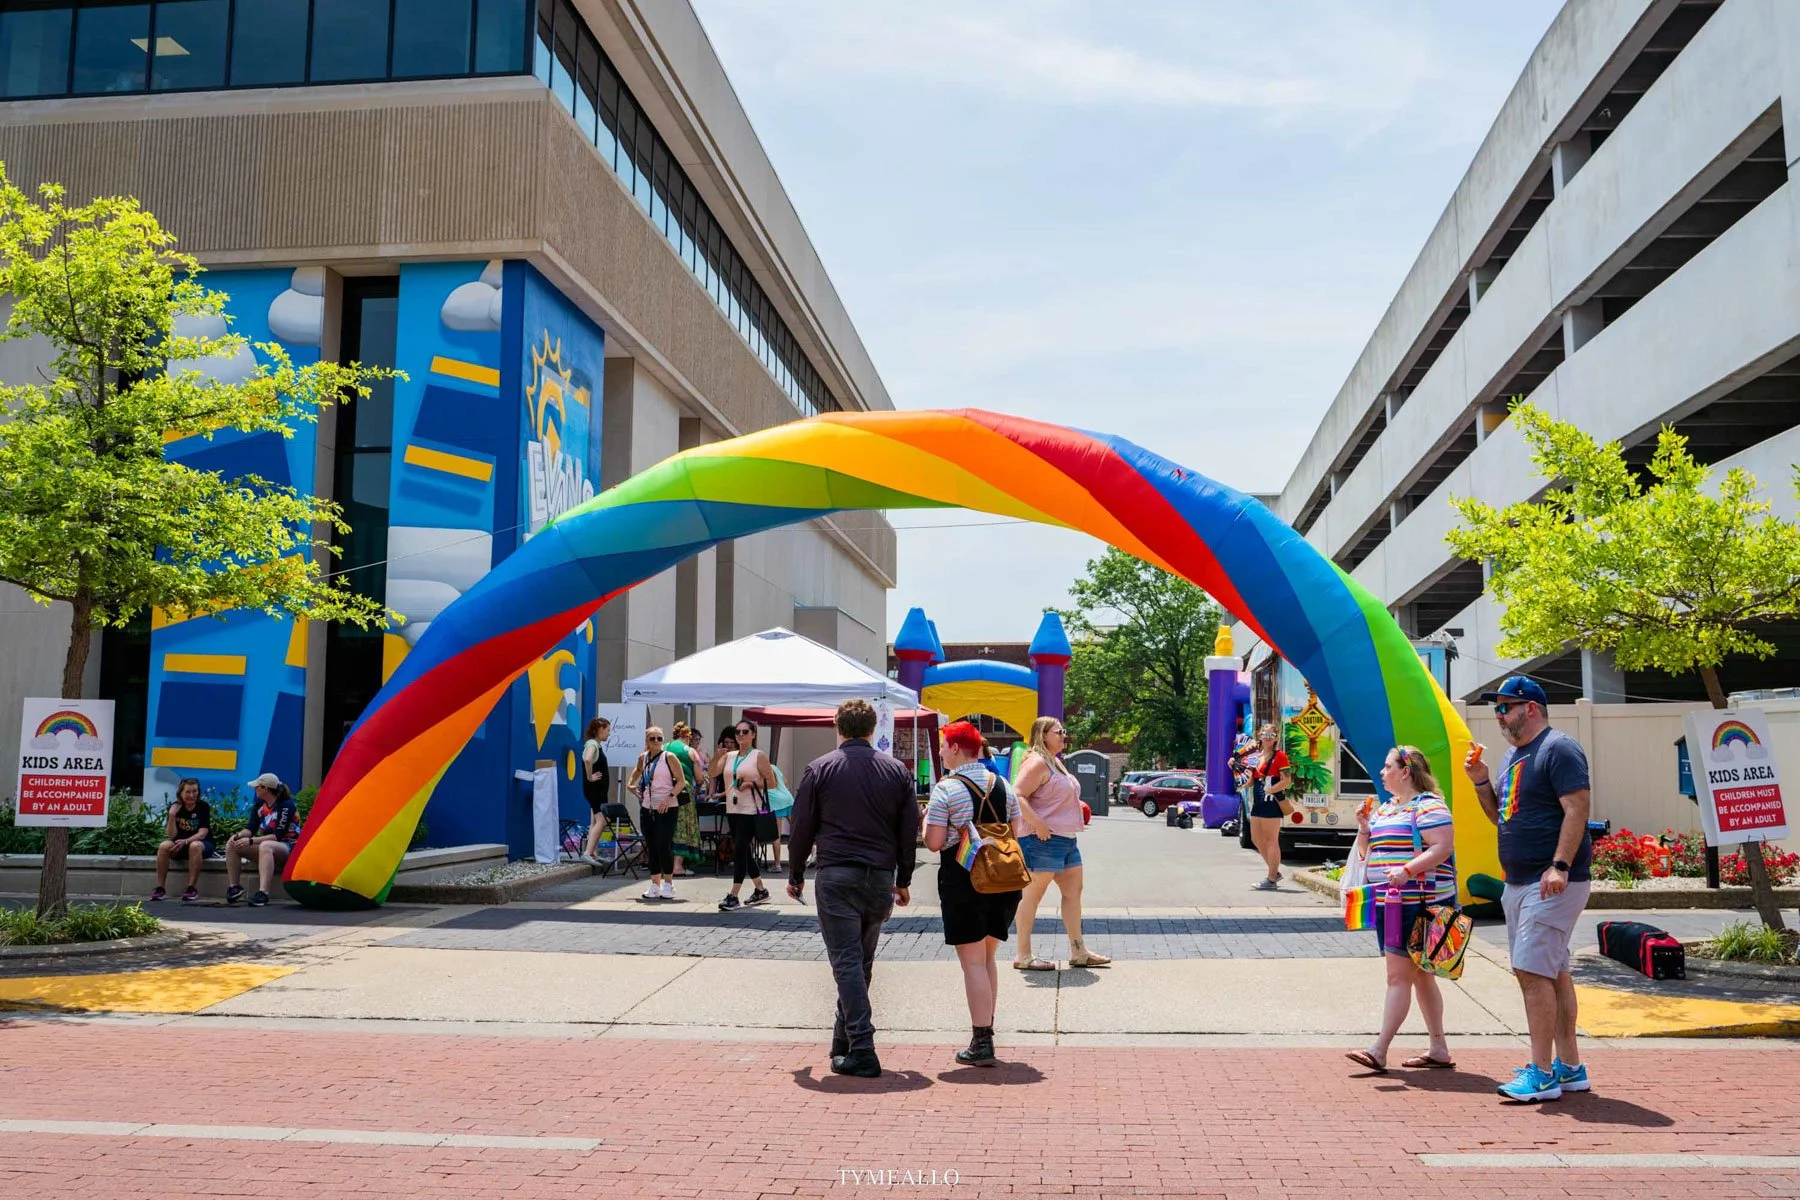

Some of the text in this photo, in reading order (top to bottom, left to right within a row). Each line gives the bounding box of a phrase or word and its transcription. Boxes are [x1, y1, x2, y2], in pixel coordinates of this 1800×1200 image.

[1303, 716, 1323, 724] CAUTION
[22, 756, 104, 770] KIDS AREA
[1709, 766, 1775, 784] KIDS AREA
[28, 778, 99, 788] CHILDREN MUST
[23, 790, 104, 800] BE ACCOMPANIED
[1720, 788, 1775, 801] CHILDREN MUST
[32, 803, 93, 812] BY AN ADULT
[1718, 801, 1782, 815] BE ACCOMPANIED
[1729, 814, 1777, 827] BY AN ADULT
